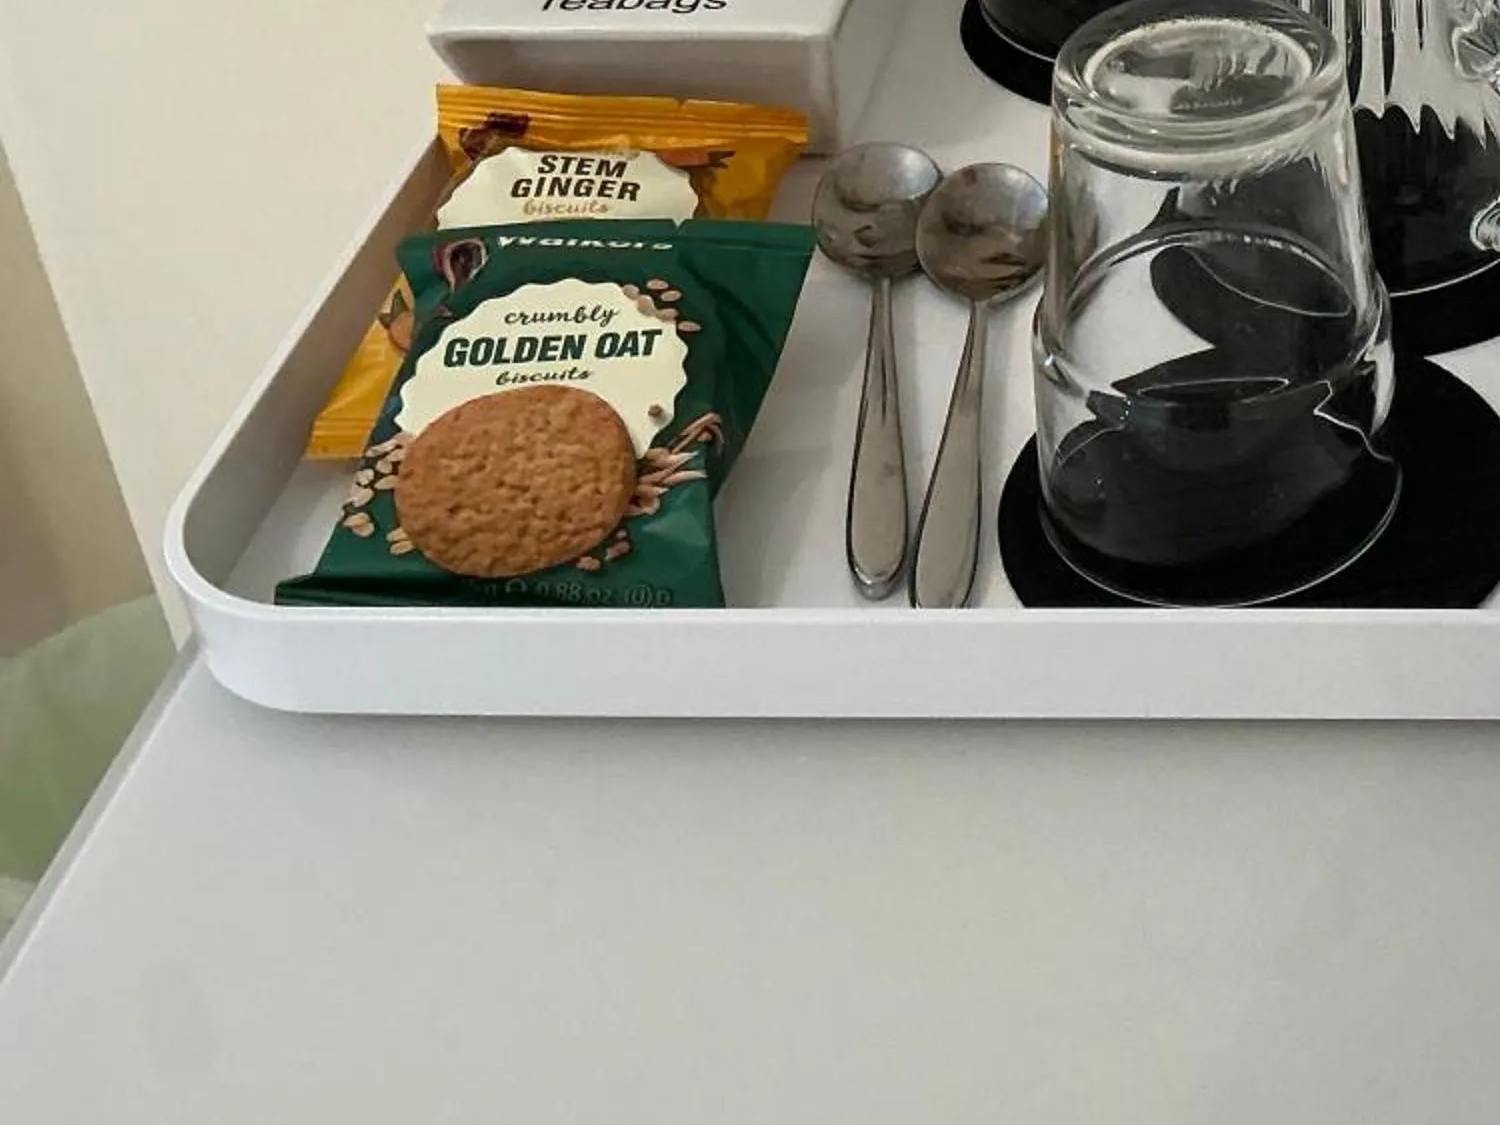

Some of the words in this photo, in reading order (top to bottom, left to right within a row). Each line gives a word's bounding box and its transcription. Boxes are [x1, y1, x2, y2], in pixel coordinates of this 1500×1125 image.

[537, 153, 628, 179] STEM
[510, 176, 642, 203] GINGER
[522, 200, 611, 216] biscuits
[503, 304, 620, 327] crumbly
[443, 334, 588, 368] GOLDEN
[594, 328, 664, 360] OAT
[494, 365, 596, 386] biscuits
